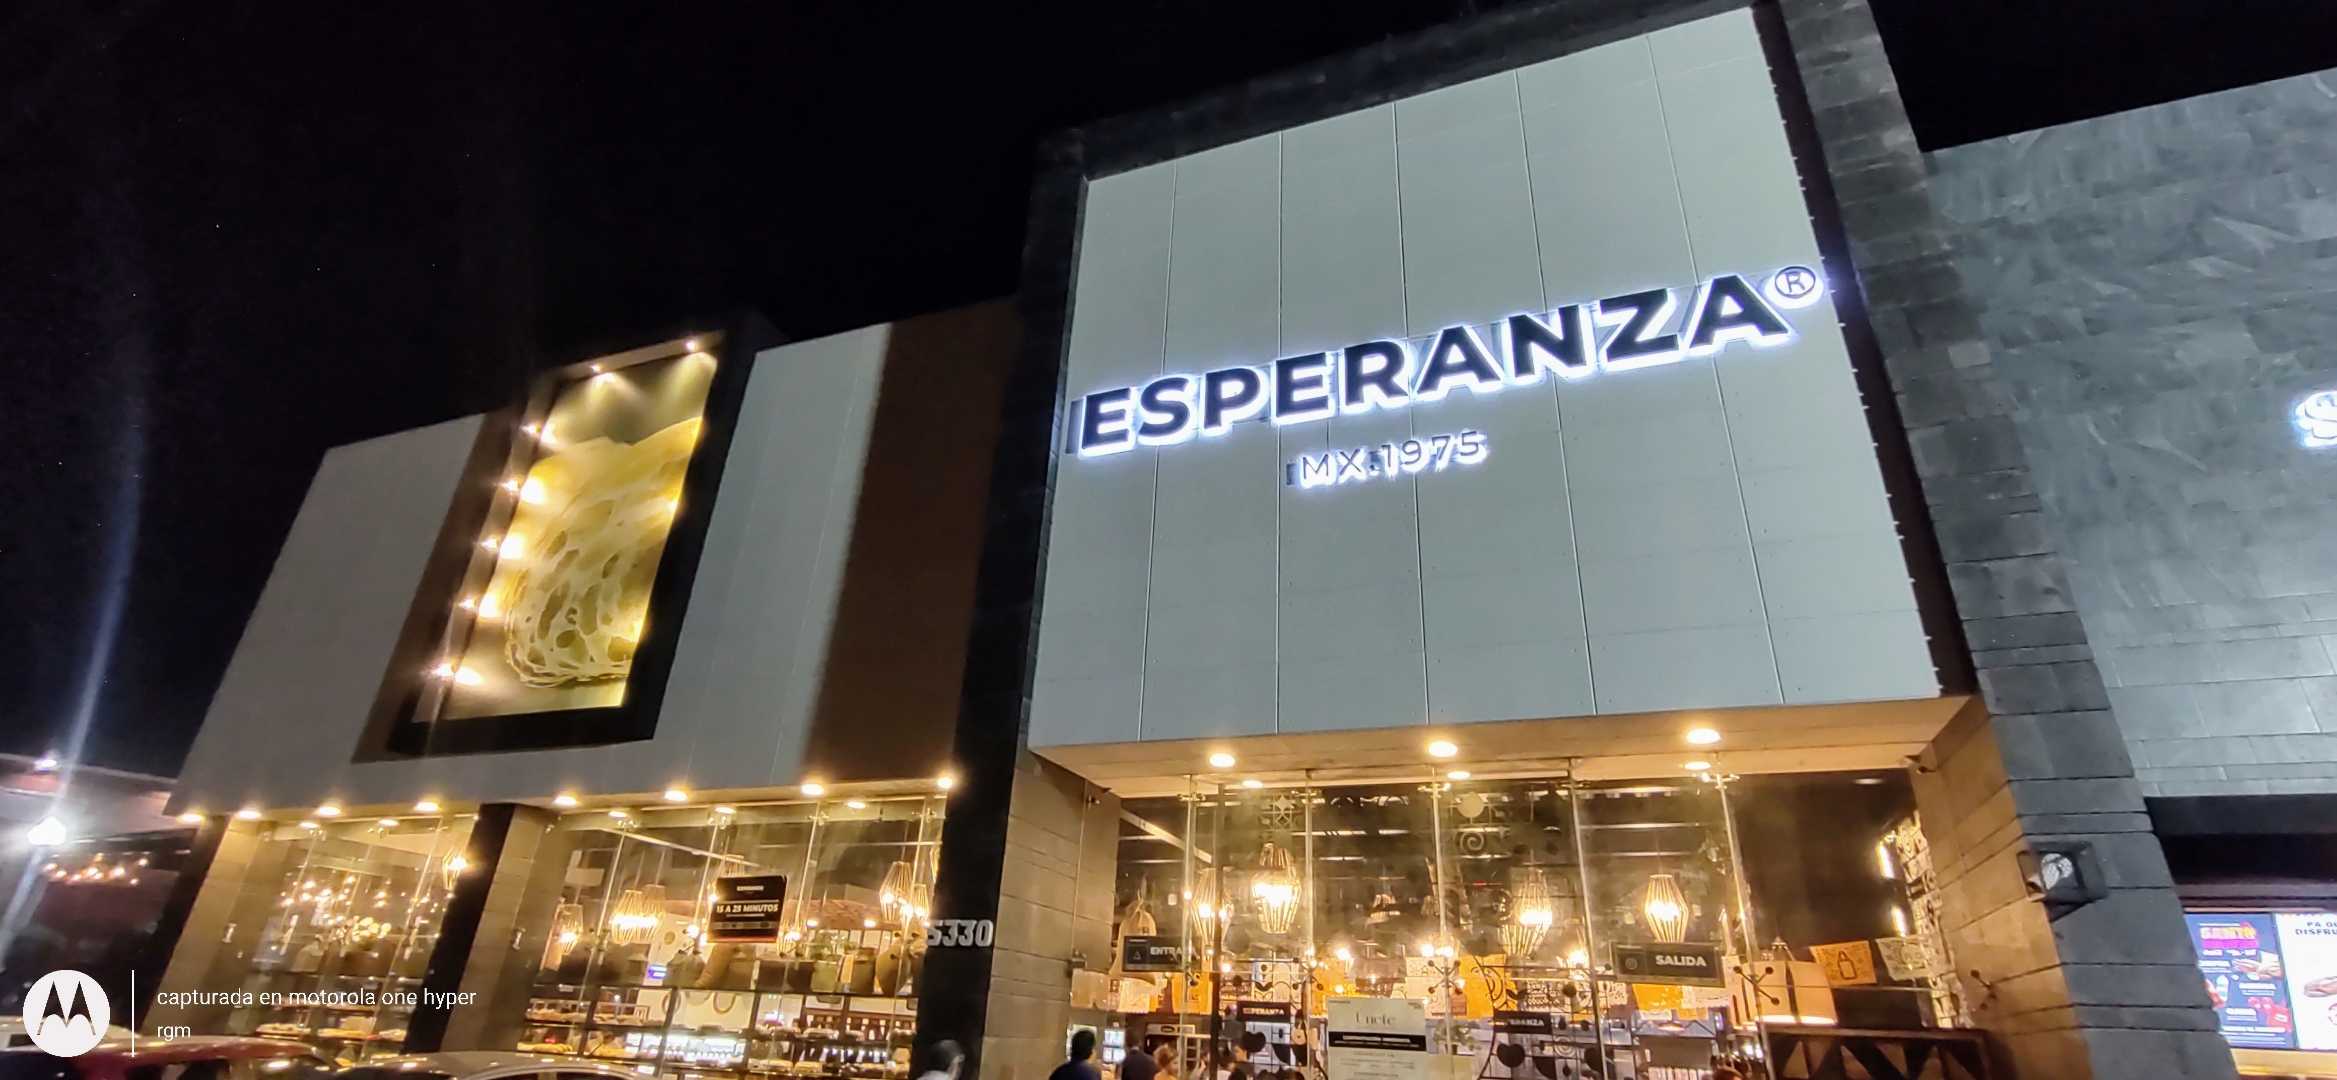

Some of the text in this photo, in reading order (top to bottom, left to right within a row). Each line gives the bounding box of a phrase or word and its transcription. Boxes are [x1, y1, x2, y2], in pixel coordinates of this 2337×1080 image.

[1080, 273, 1790, 450] ESPERANZA
[743, 904, 778, 912] MINUTOS
[926, 919, 993, 947] 5330
[1150, 946, 1192, 956] ENTRA
[1655, 954, 1707, 967] SALIDA
